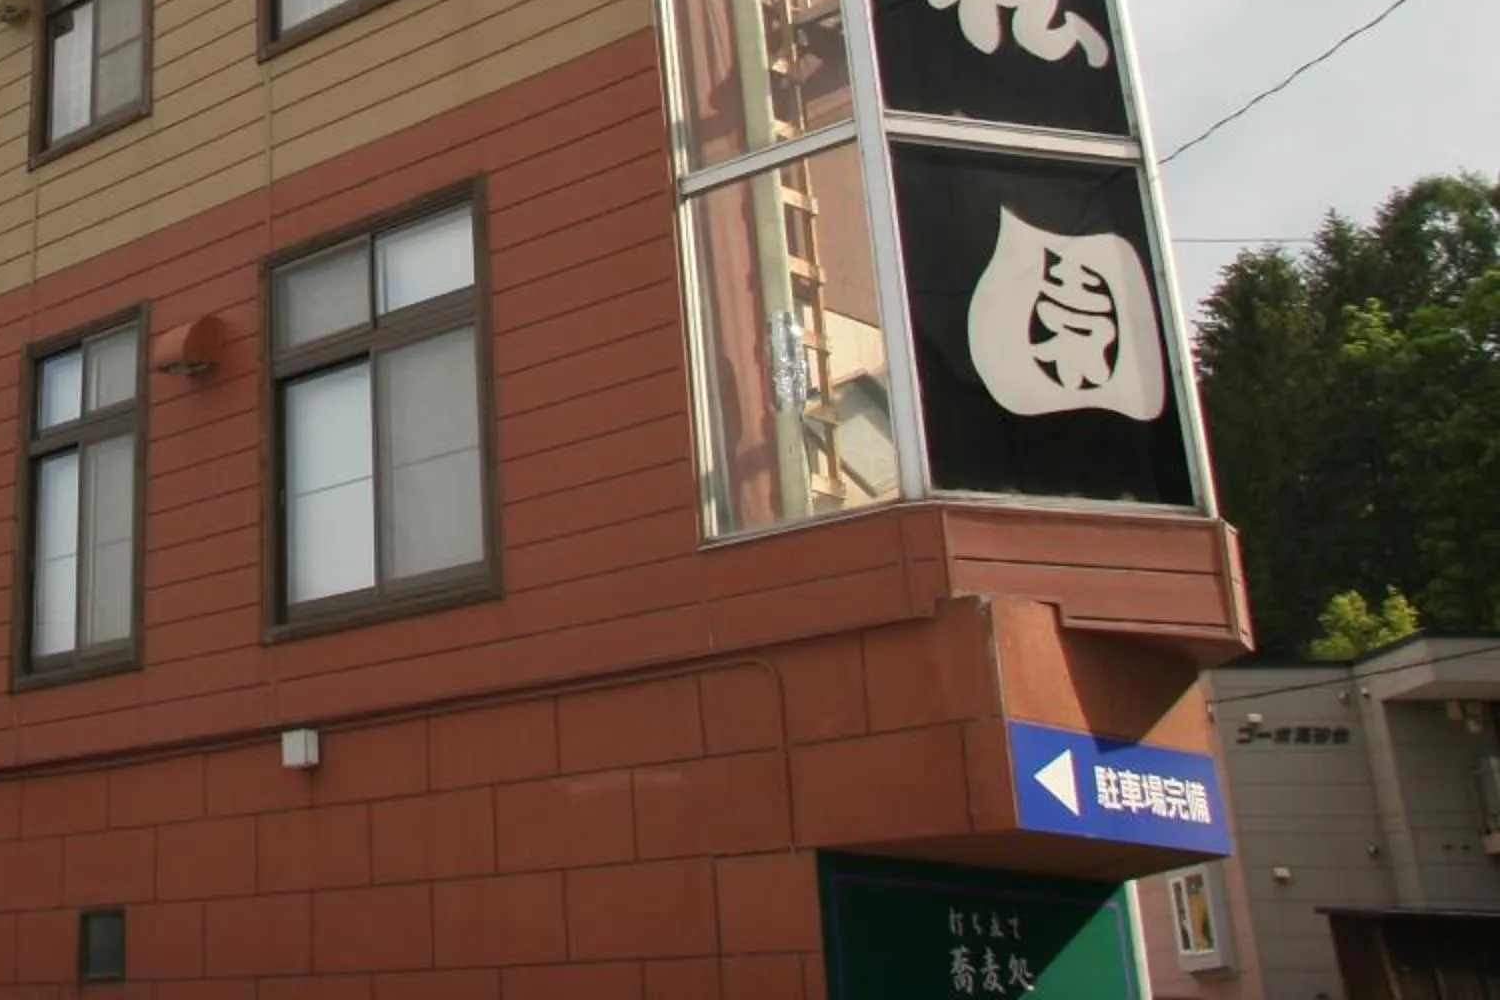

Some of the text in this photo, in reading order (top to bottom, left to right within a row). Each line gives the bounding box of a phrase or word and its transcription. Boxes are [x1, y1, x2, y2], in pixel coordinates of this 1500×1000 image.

[1093, 765, 1211, 824] 駐車場完備
[949, 945, 1035, 995] 蕎麦処
